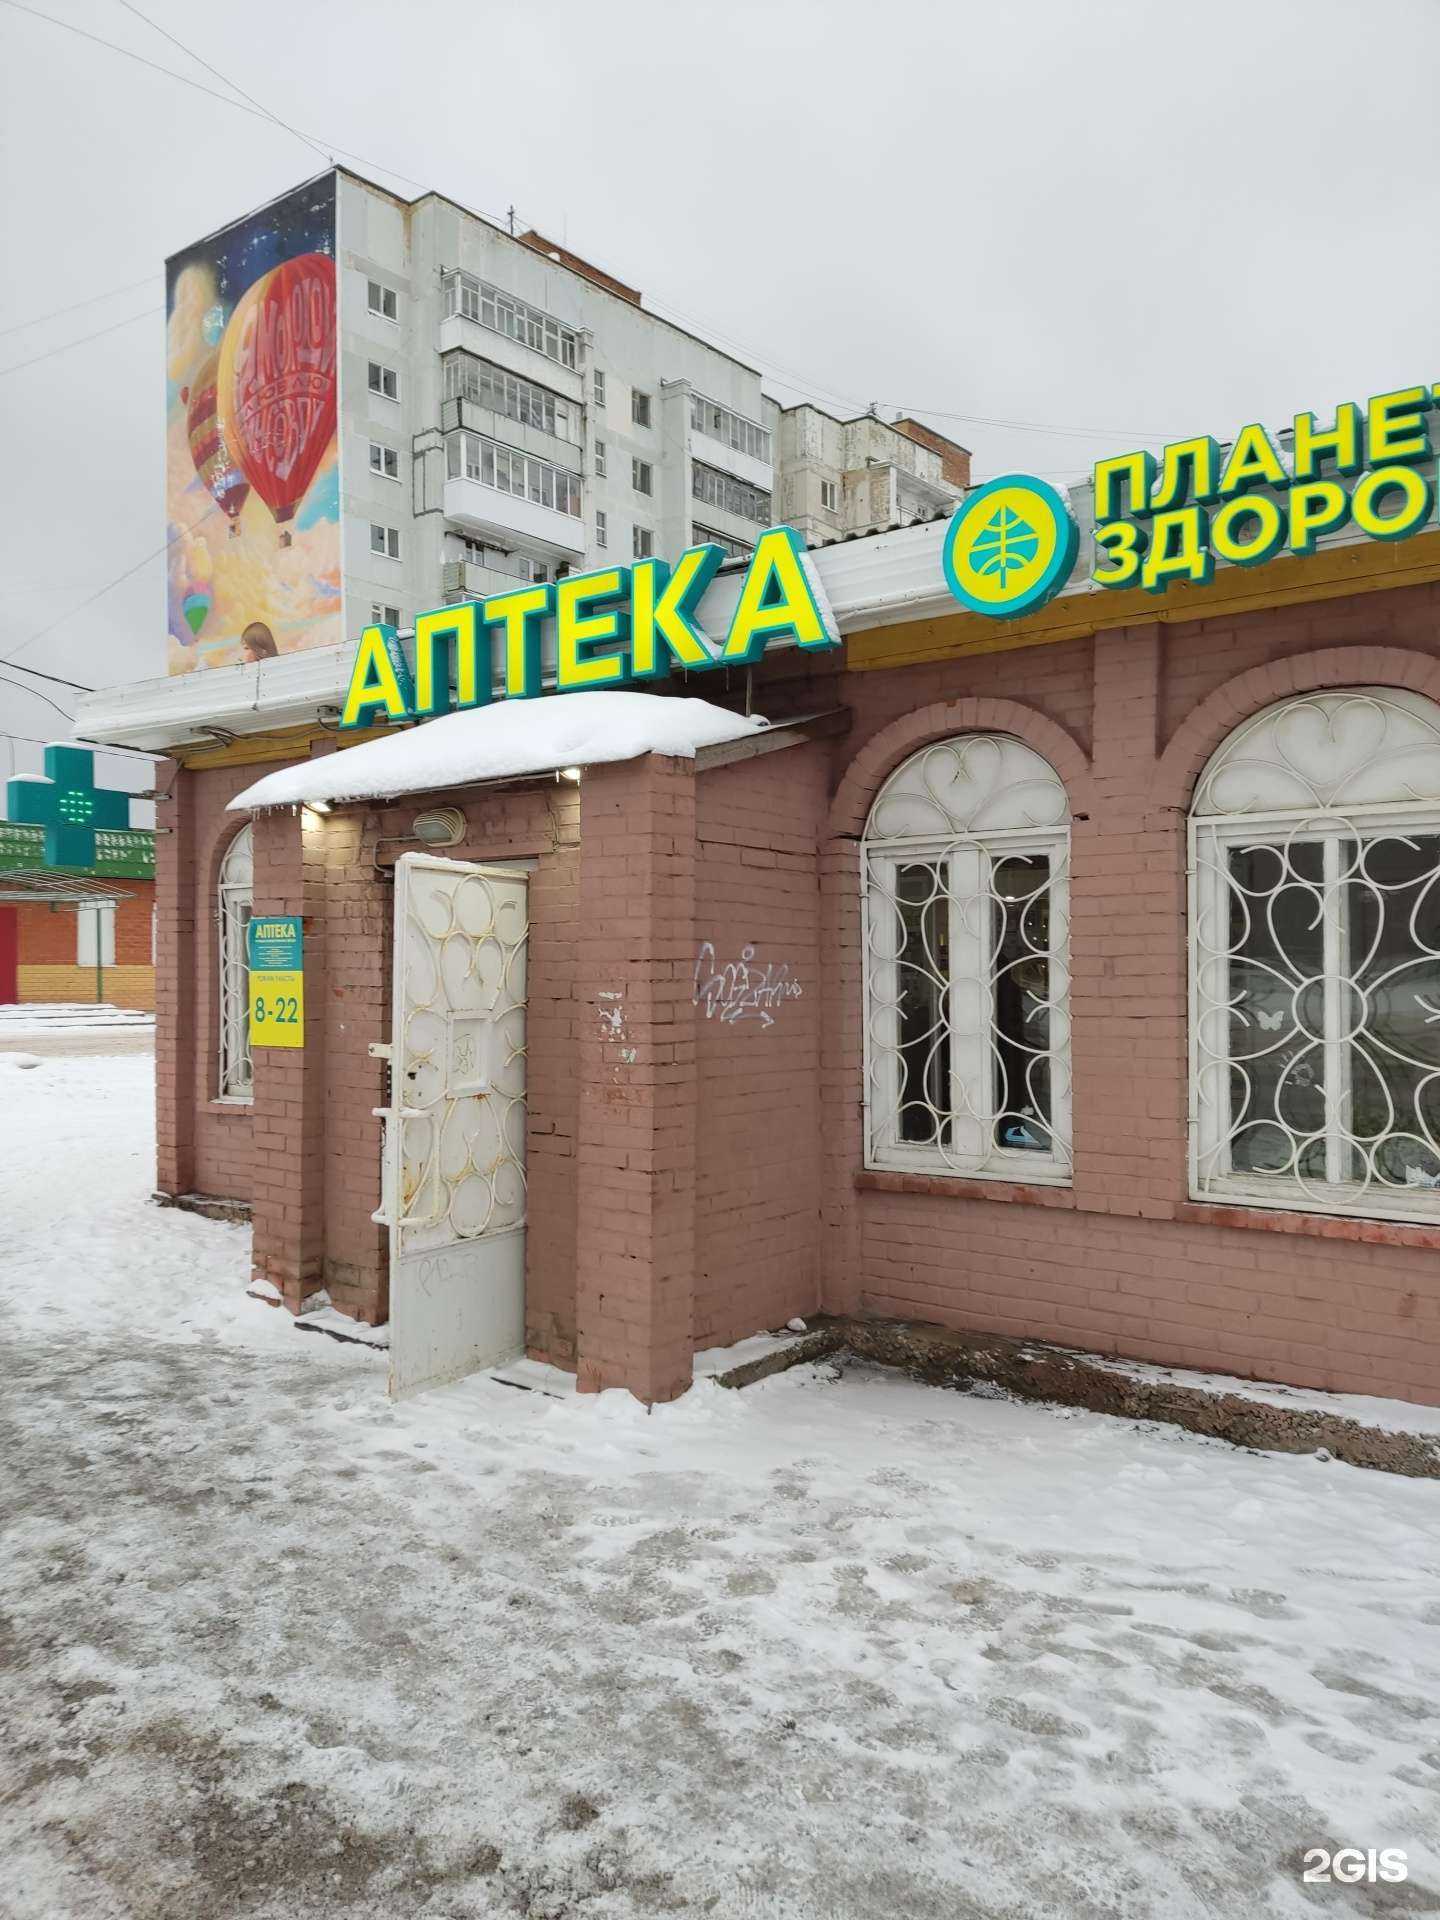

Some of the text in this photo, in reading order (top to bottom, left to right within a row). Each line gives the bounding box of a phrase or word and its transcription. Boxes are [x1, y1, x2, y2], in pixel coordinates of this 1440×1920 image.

[1094, 382, 1440, 520] ПЛАНЕ
[1091, 464, 1440, 593] ЗДОРО
[339, 525, 841, 729] АПТЕКА
[255, 923, 296, 938] АПТЕКА
